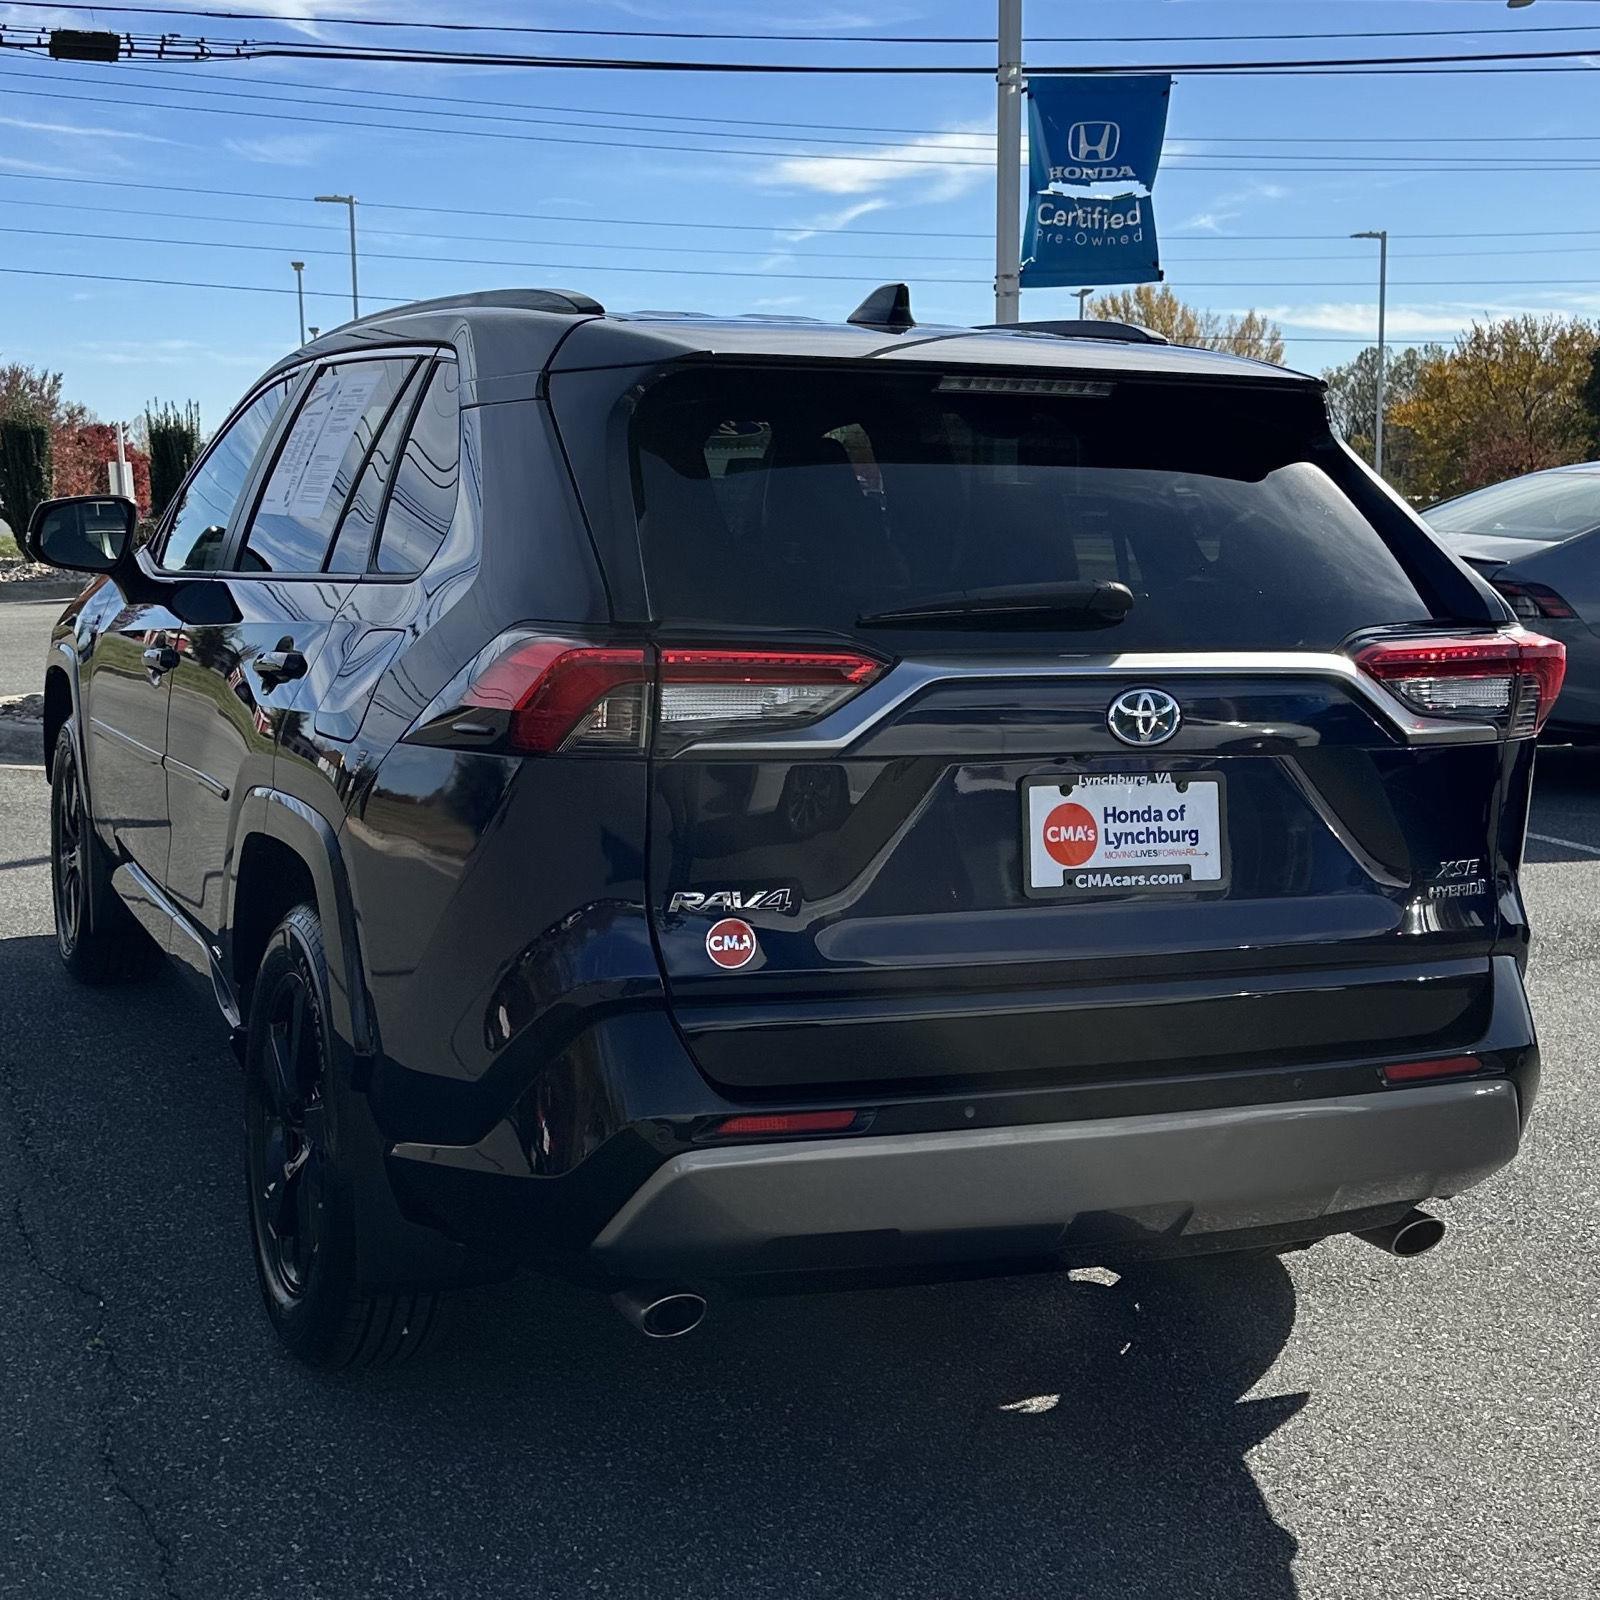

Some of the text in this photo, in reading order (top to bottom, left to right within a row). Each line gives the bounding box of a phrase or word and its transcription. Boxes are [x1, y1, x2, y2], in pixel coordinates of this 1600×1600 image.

[1048, 166, 1136, 180] HONDA
[1037, 201, 1142, 230] Certified
[1036, 228, 1143, 246] Pre-Owned
[1078, 773, 1173, 786] Lynchburg, VA
[1103, 804, 1186, 824] Honda of
[1046, 826, 1096, 843] CMA's
[1104, 826, 1200, 849] Lynchburg
[1435, 858, 1480, 878] XSE
[1075, 873, 1184, 888] CMAcars.com
[667, 888, 792, 912] RAV4
[709, 934, 752, 952] CMA
